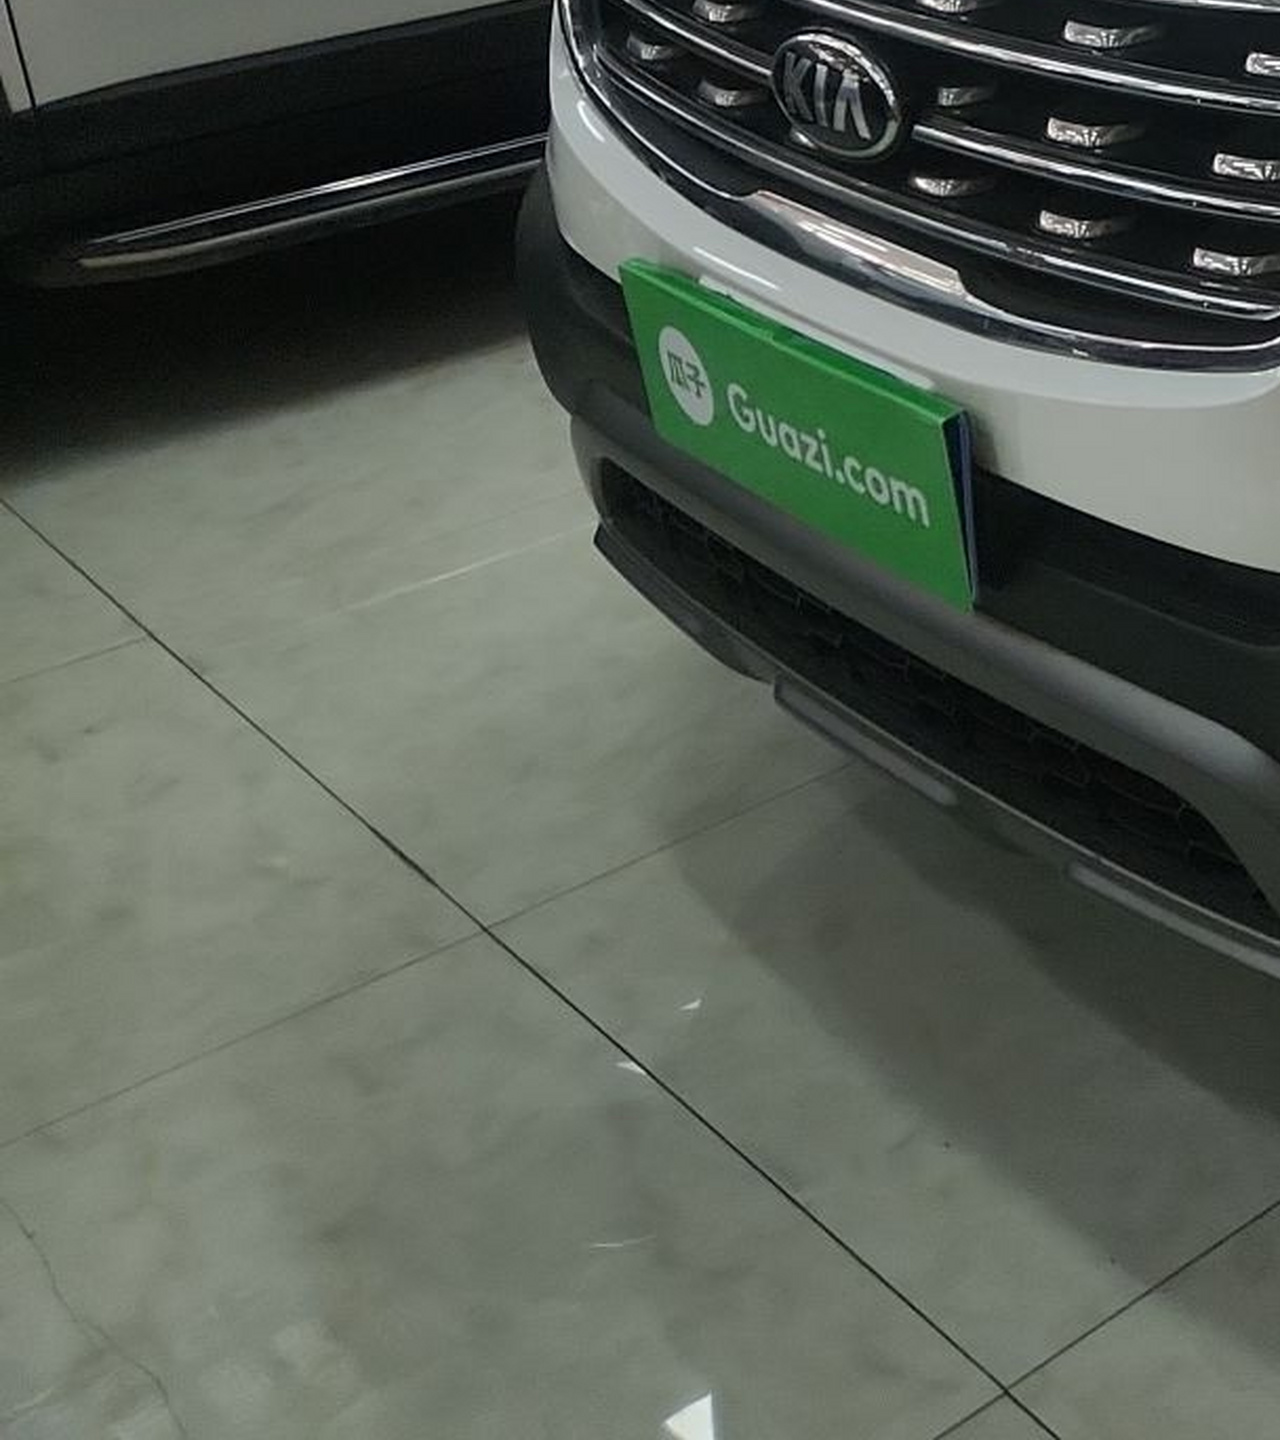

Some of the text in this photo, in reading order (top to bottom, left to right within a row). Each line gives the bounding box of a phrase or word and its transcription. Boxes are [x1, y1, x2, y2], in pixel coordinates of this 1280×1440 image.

[783, 51, 872, 141] KIA
[666, 350, 707, 398] 瓜子
[726, 382, 931, 529] Guazi.com
